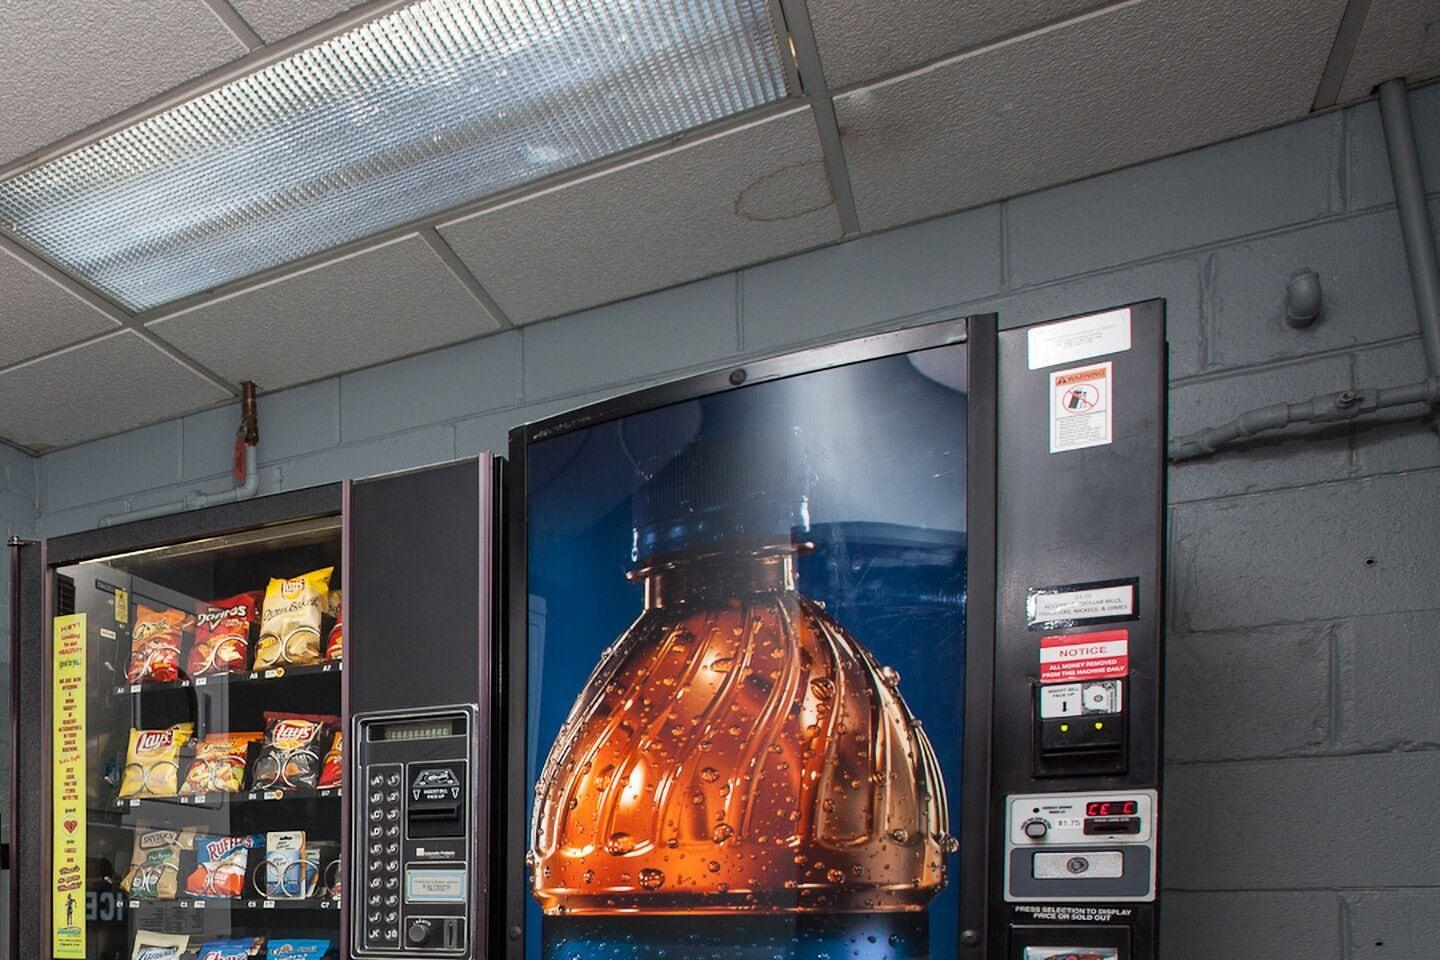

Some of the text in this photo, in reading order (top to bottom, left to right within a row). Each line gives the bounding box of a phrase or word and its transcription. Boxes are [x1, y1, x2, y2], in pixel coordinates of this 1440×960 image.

[197, 605, 247, 628] Doritos
[1059, 646, 1107, 657] NOTICE
[1062, 662, 1084, 670] MONEY
[1085, 659, 1117, 667] REMOVED
[277, 723, 312, 741] Lay's
[137, 731, 173, 750] Lay's
[207, 834, 254, 860] RUFFLES
[1015, 905, 1041, 913] PRESS
[1042, 906, 1085, 914] SELECTION
[1098, 908, 1132, 916] DISPLAY
[1072, 913, 1093, 921] SOLD
